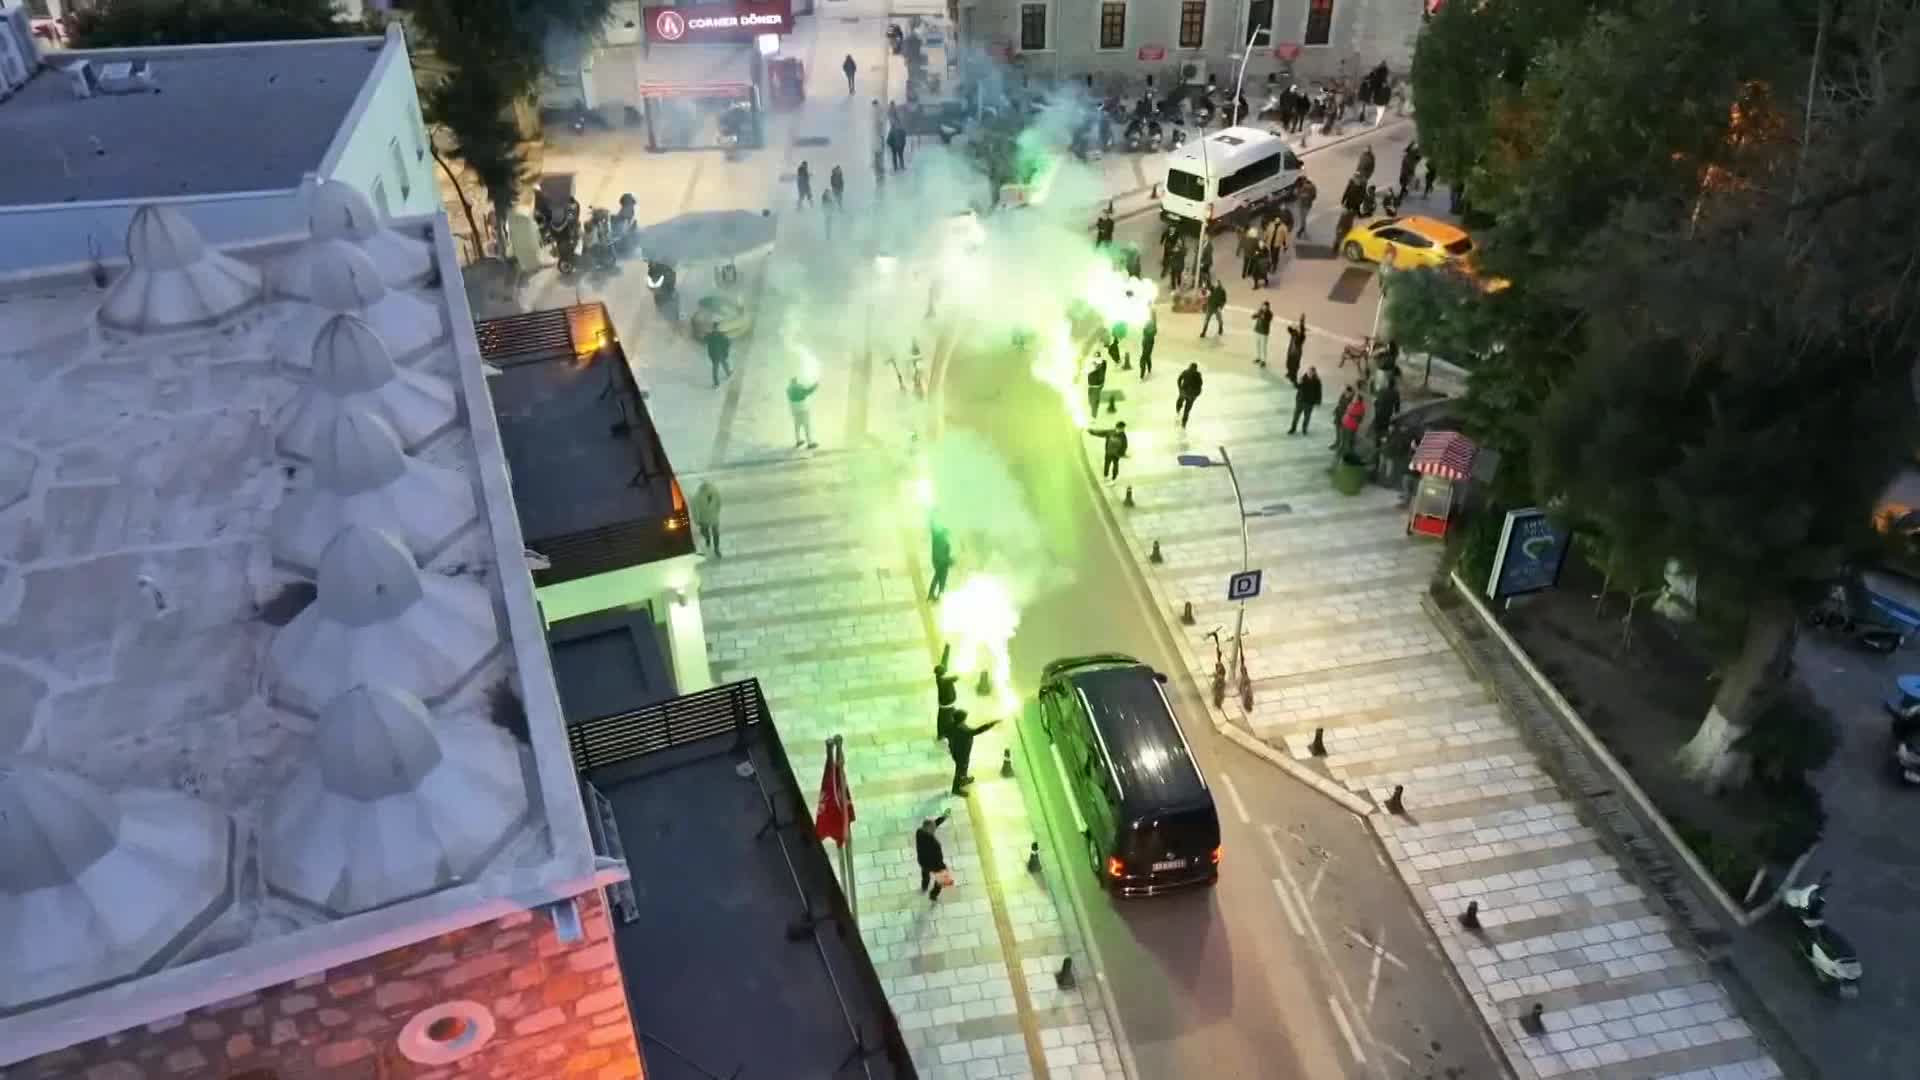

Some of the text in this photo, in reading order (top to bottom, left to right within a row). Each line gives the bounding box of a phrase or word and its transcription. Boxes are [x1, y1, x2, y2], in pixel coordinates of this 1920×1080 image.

[688, 13, 782, 29] CORNER DÖNER
[1237, 578, 1252, 593] D
